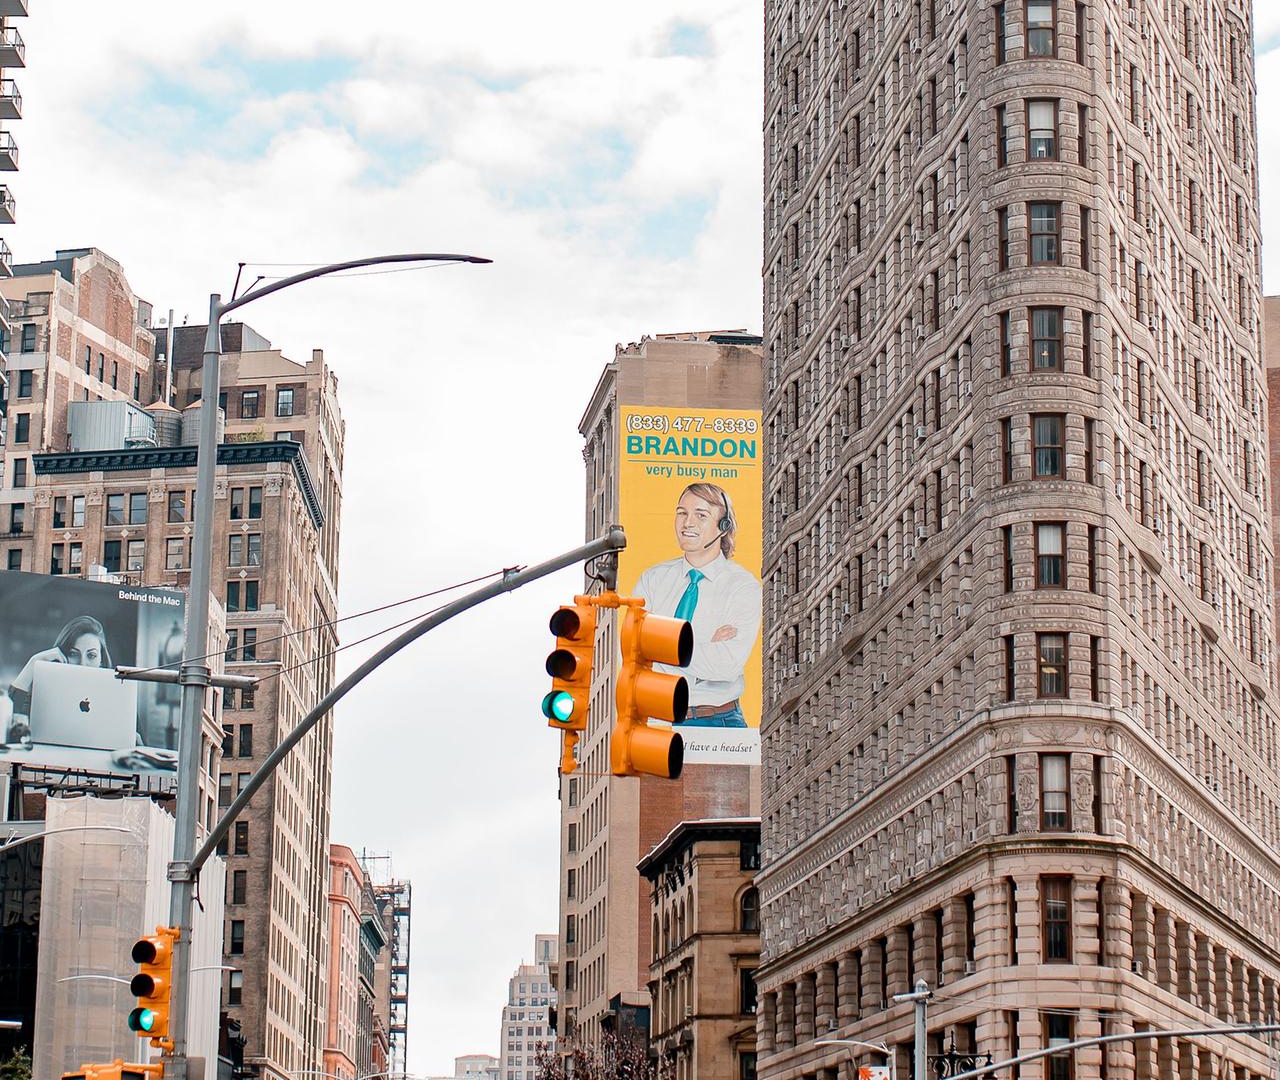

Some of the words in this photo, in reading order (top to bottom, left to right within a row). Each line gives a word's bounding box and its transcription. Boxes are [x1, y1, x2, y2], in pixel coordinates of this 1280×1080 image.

[626, 414, 669, 434] (833)
[672, 416, 758, 434] 477-8339
[626, 435, 757, 459] BRANDON
[646, 465, 673, 478] very
[677, 464, 706, 479] busy
[710, 467, 738, 478] man
[118, 590, 147, 602] Behind
[148, 594, 162, 604] the
[163, 595, 181, 606] Mac
[689, 741, 710, 752] have
